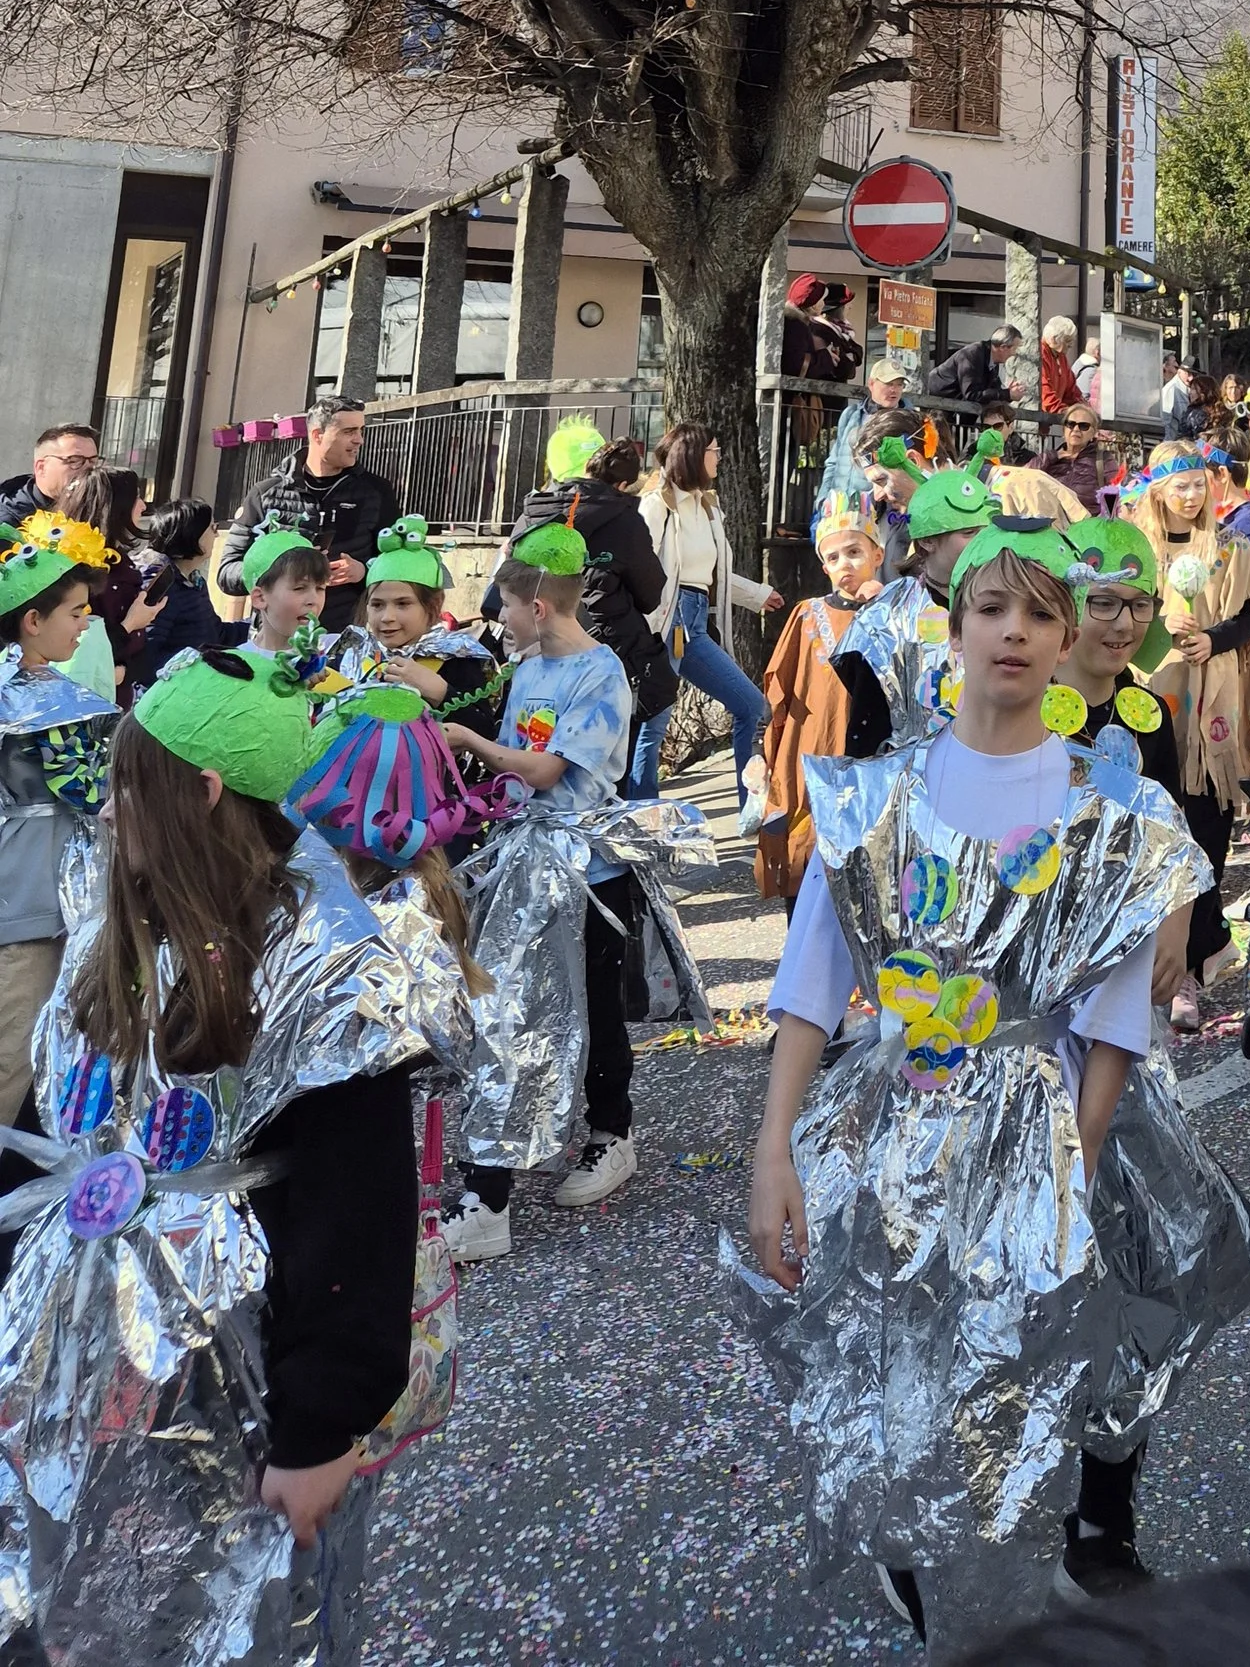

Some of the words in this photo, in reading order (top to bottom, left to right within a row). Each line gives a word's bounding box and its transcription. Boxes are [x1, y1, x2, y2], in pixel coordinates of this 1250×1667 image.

[1121, 59, 1135, 235] RISTORANTE
[1118, 240, 1154, 253] CAMERE
[883, 288, 893, 301] Via
